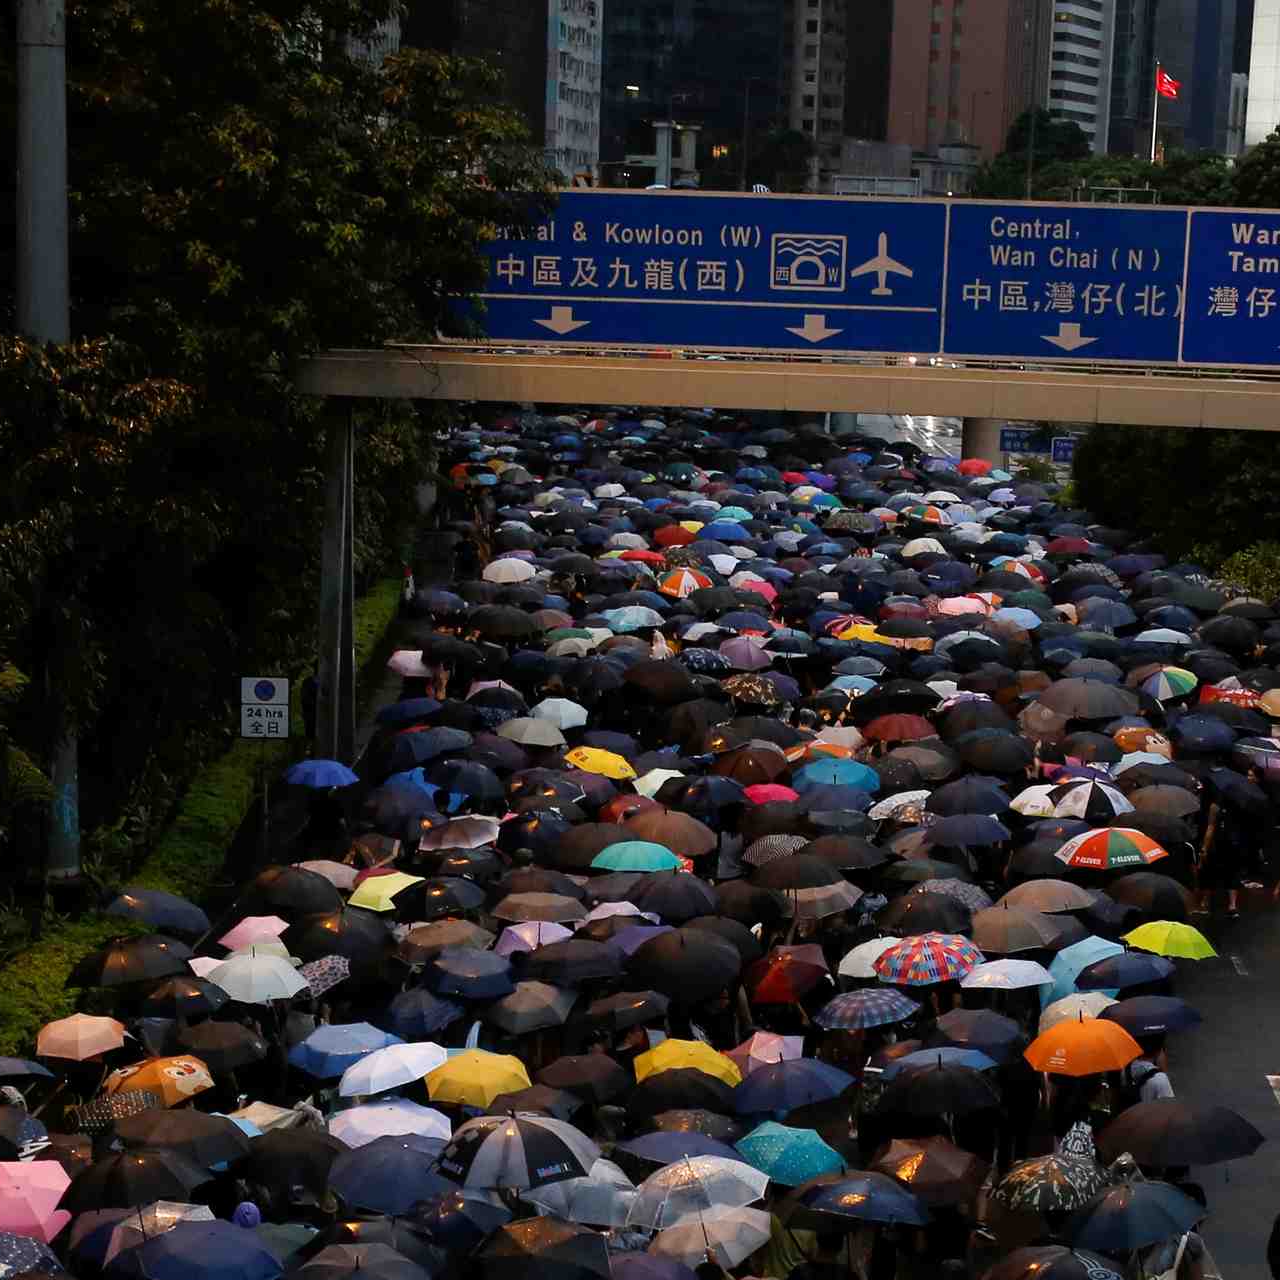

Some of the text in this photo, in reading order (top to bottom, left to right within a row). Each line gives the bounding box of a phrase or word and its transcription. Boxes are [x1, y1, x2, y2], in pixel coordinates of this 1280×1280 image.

[572, 221, 587, 241] &
[606, 222, 704, 246] Kowloon
[721, 224, 761, 248] (W)
[990, 244, 1035, 268] Wan
[1048, 246, 1097, 270] Chai
[496, 253, 744, 292] 中區及九龍(西)
[247, 708, 283, 718] 24 hrs
[249, 721, 279, 734] 全日
